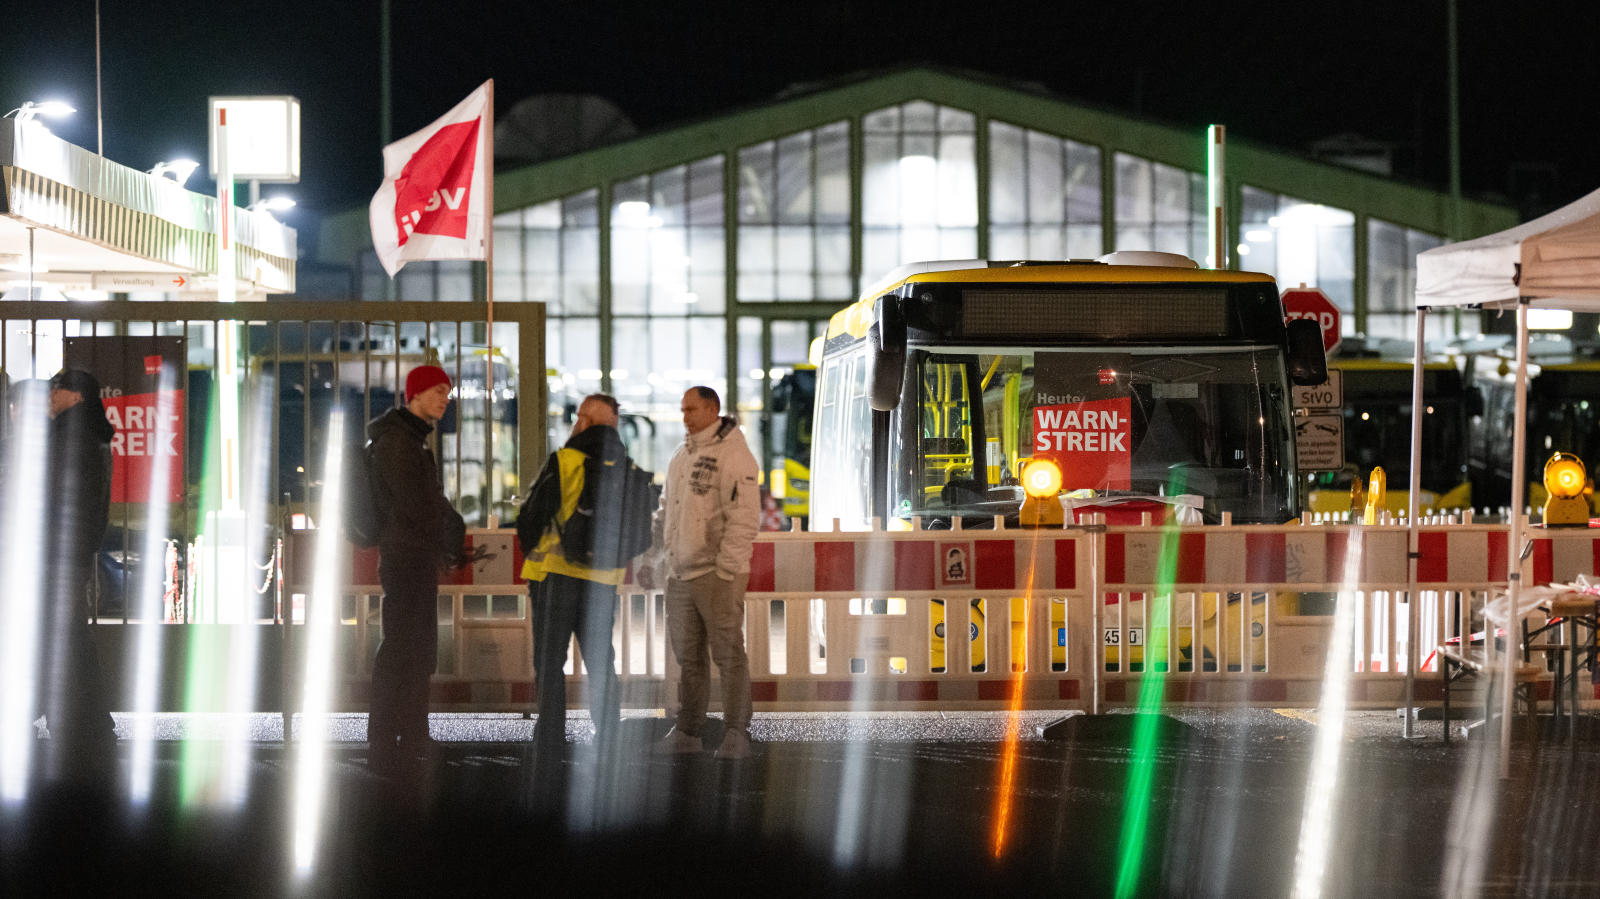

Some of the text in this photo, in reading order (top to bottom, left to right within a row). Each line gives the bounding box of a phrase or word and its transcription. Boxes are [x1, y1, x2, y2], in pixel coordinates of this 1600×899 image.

[112, 277, 155, 287] Verwaltung
[1037, 393, 1080, 404] Heute
[1301, 391, 1333, 405] StVO
[105, 406, 179, 430] ARN-
[1037, 410, 1127, 430] WARN-
[110, 432, 179, 456] REIK
[1036, 431, 1127, 452] STREIK
